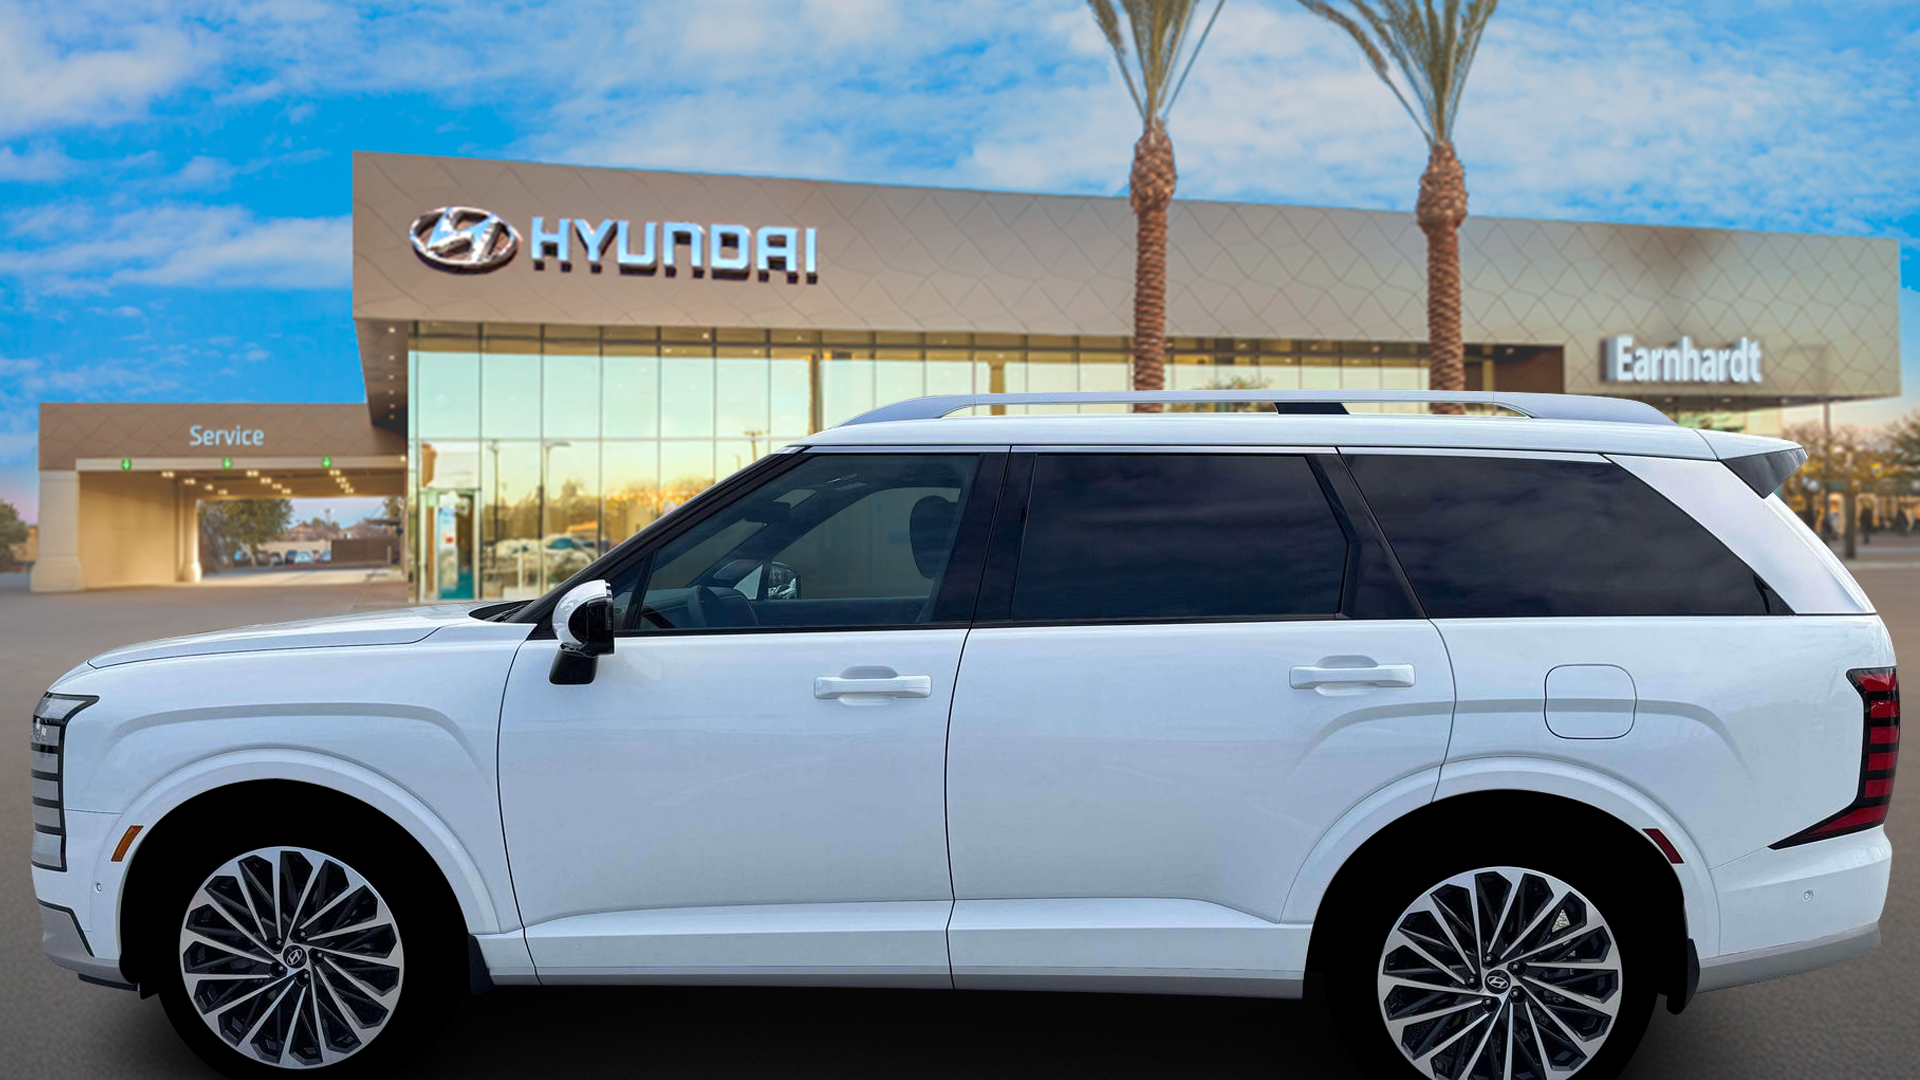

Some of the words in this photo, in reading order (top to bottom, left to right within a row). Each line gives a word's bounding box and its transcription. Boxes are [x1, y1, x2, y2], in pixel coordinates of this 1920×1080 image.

[530, 215, 818, 281] HYUNDAI
[1613, 335, 1763, 383] Earnhardt
[189, 424, 265, 446] Service
